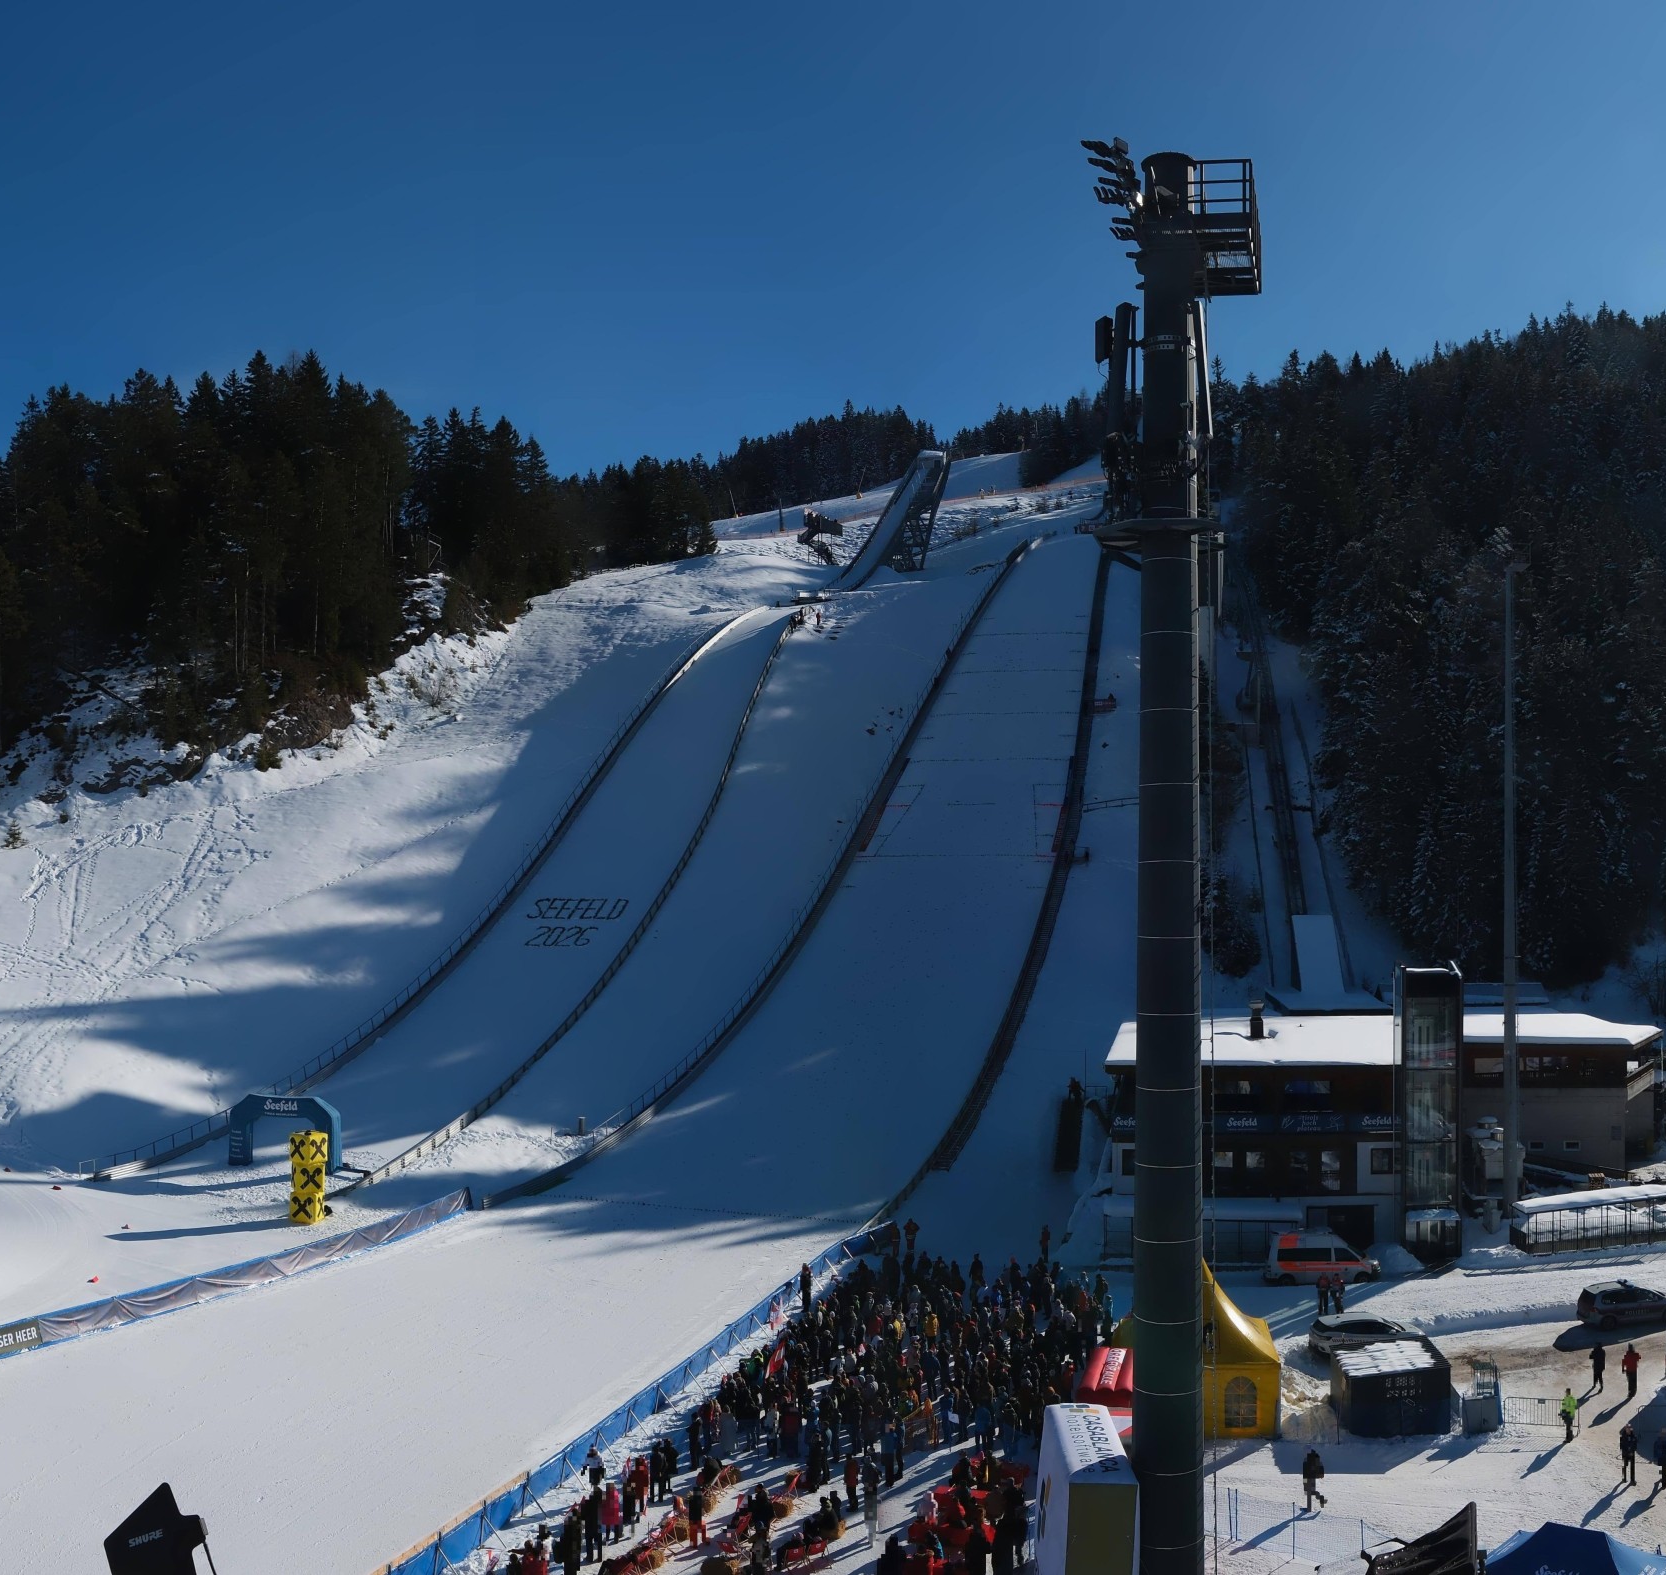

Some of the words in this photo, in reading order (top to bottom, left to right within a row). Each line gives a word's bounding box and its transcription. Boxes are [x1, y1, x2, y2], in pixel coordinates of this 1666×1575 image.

[527, 898, 629, 920] SEEFELD
[525, 925, 598, 947] 2026
[264, 1099, 298, 1112] Seefeld
[1114, 1117, 1136, 1126] Seefe
[1227, 1118, 1257, 1127] Seefeld
[1362, 1116, 1393, 1126] Seefeld
[16, 1327, 38, 1344] HEER
[1083, 1415, 1120, 1473] CASABLANCA
[129, 1529, 163, 1548] SHURE
